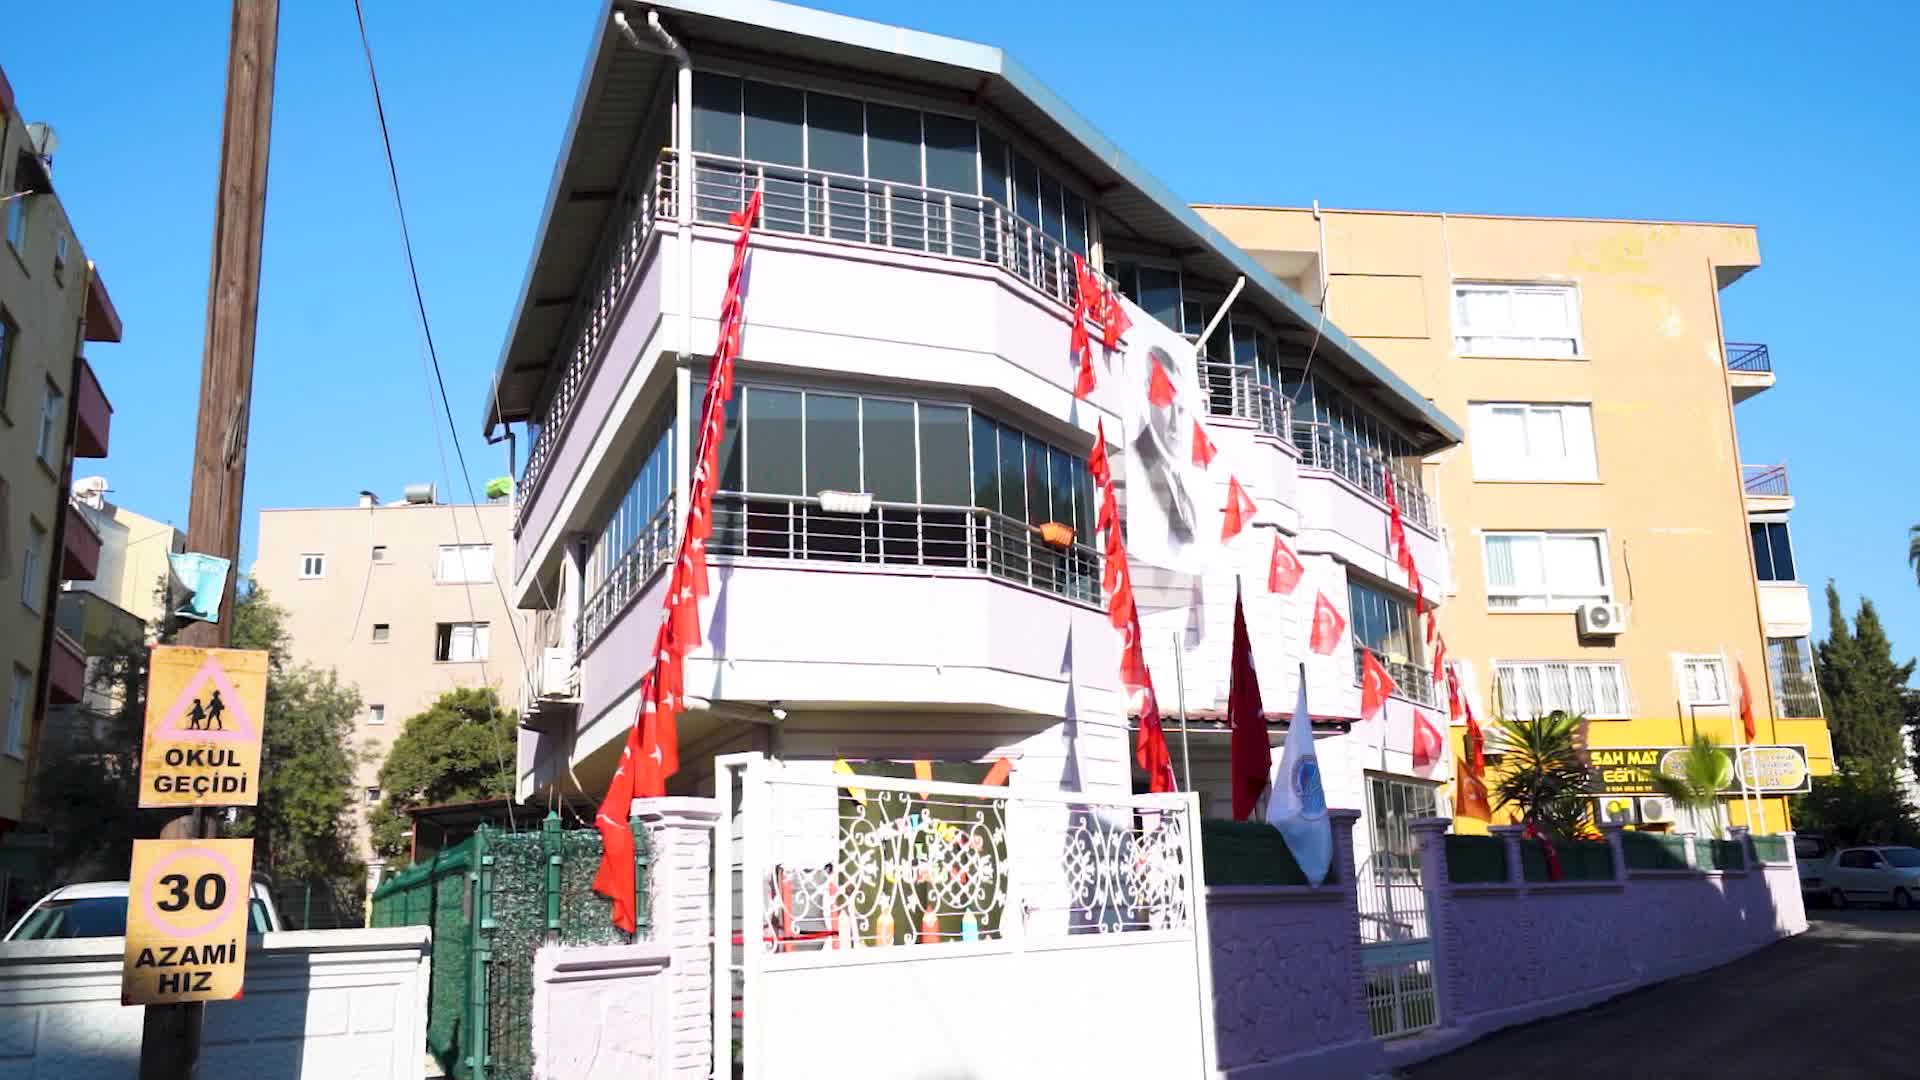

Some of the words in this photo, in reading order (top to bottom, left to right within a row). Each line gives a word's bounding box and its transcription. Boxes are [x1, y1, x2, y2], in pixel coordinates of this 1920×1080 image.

[165, 748, 241, 767] OKUL
[1627, 751, 1659, 765] MAT
[153, 770, 247, 798] GEÇİDİ
[157, 873, 227, 912] 30
[135, 939, 237, 970] AZAMİ
[157, 971, 213, 996] HIZ
